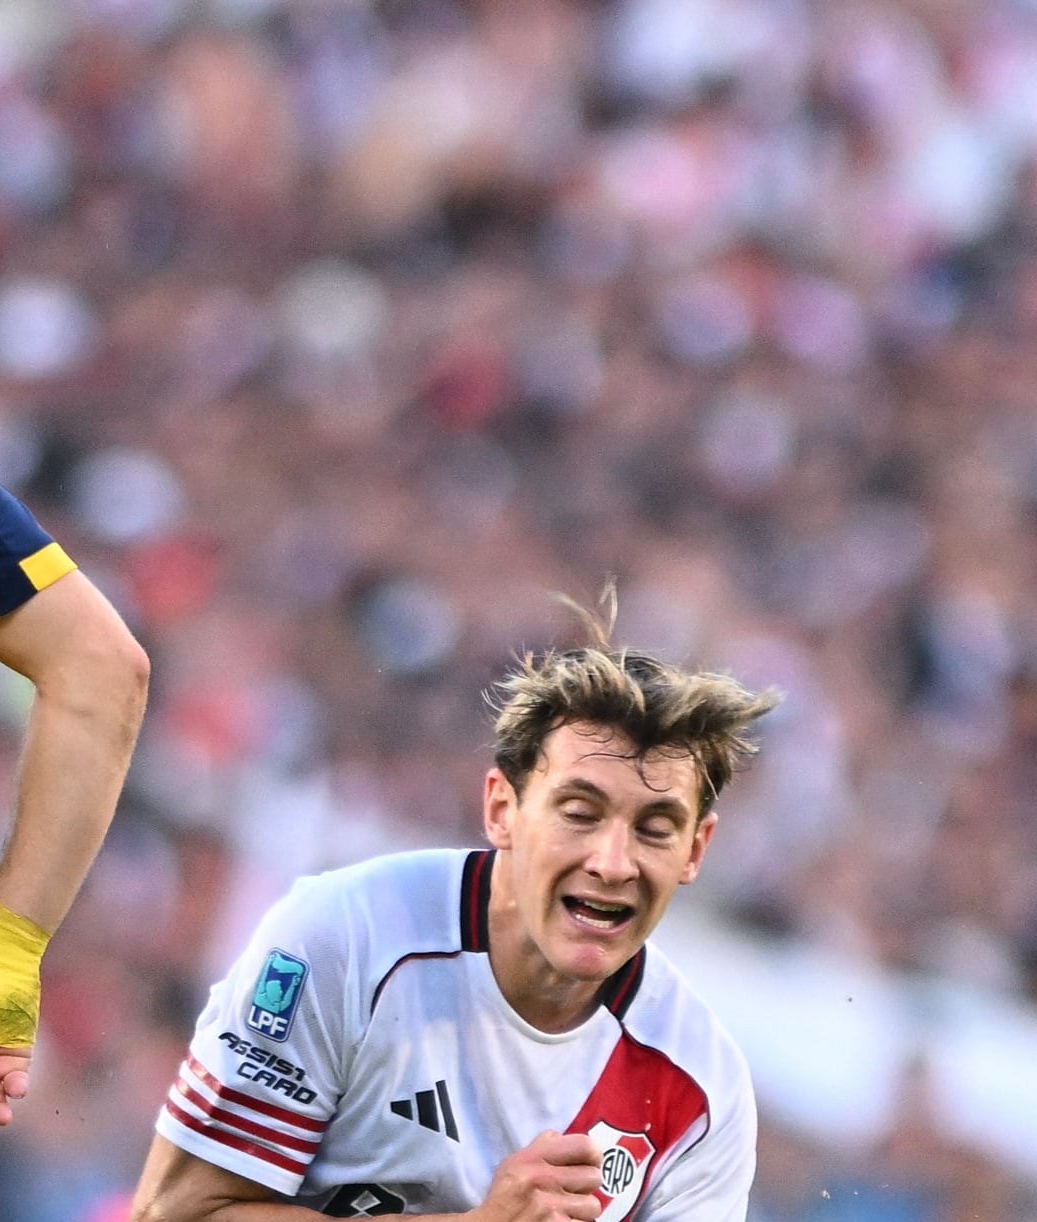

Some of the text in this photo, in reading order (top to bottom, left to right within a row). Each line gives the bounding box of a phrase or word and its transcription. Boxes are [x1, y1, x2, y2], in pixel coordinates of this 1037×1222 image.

[248, 1005, 289, 1036] LPF
[218, 1031, 306, 1082] ASSIST
[236, 1061, 318, 1104] CARD
